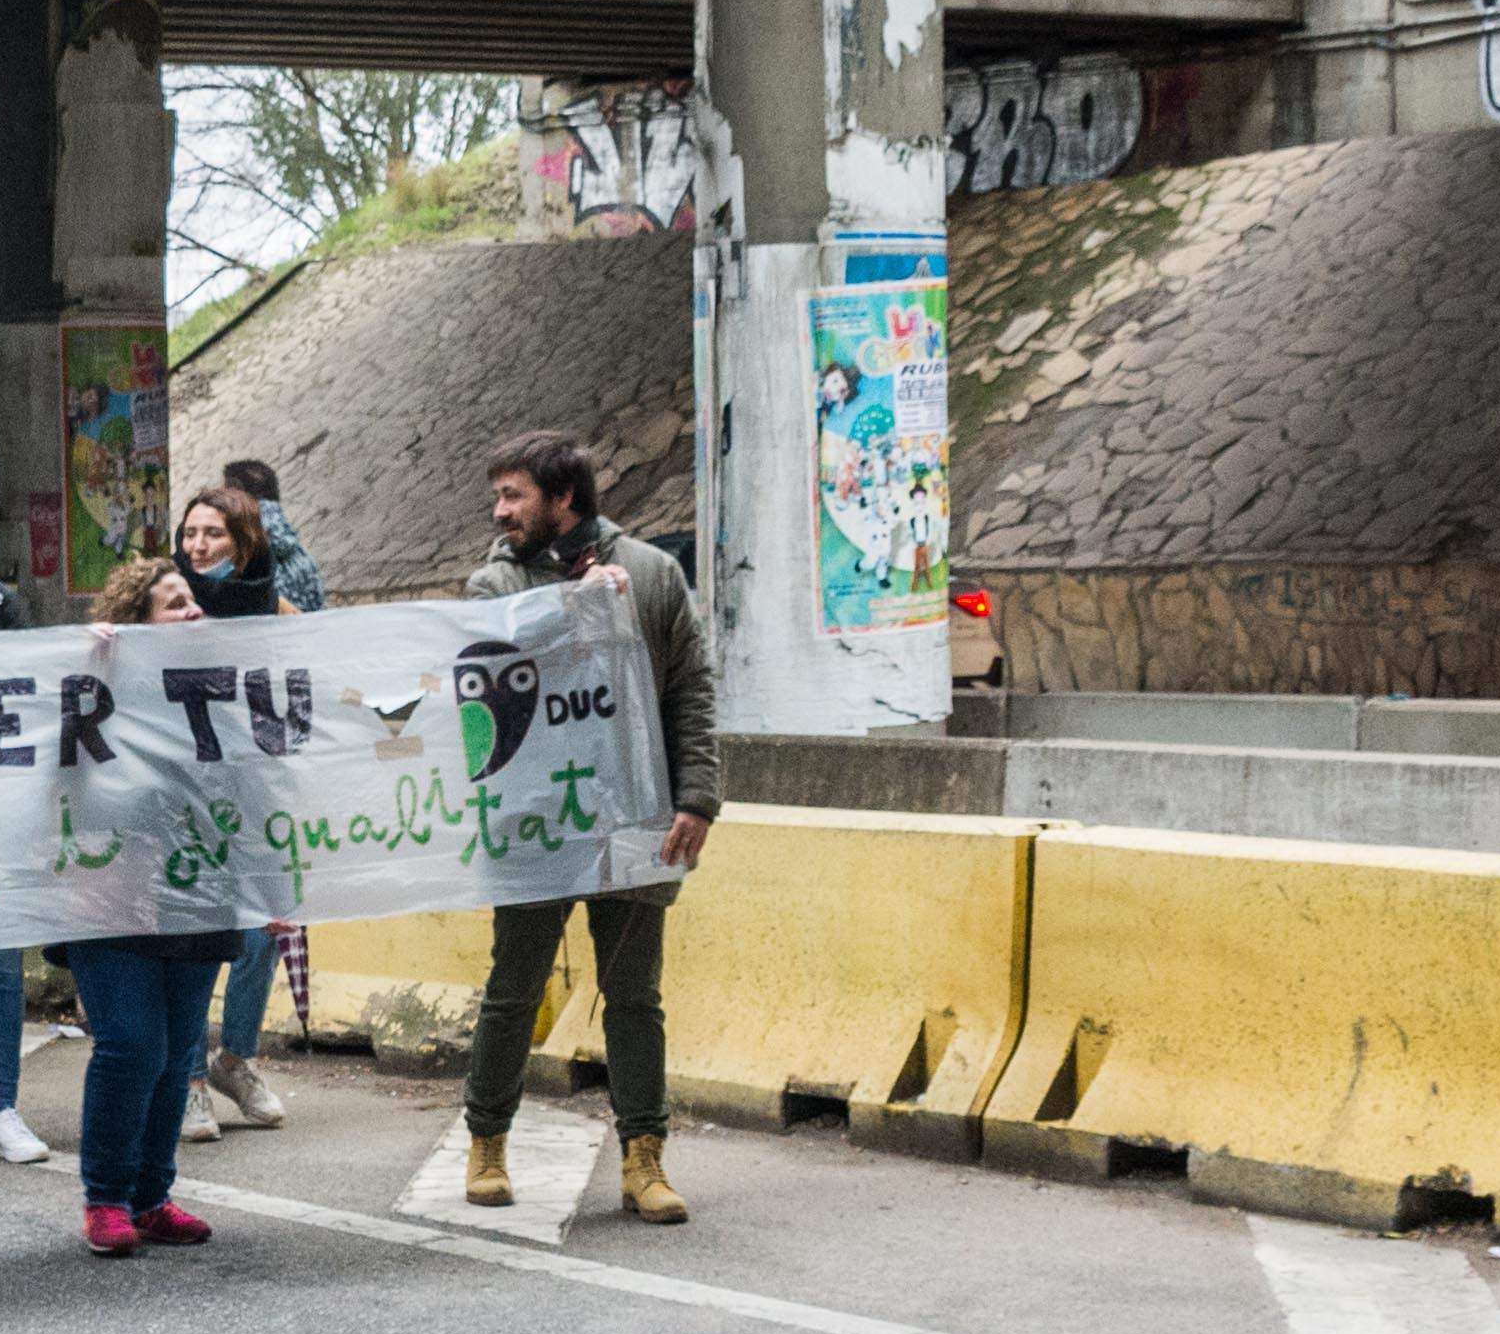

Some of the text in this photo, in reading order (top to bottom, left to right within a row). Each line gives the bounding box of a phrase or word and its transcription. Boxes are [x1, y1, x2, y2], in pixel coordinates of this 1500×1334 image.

[162, 666, 312, 763] TU
[545, 680, 617, 726] DUC
[264, 758, 598, 904] qualitat
